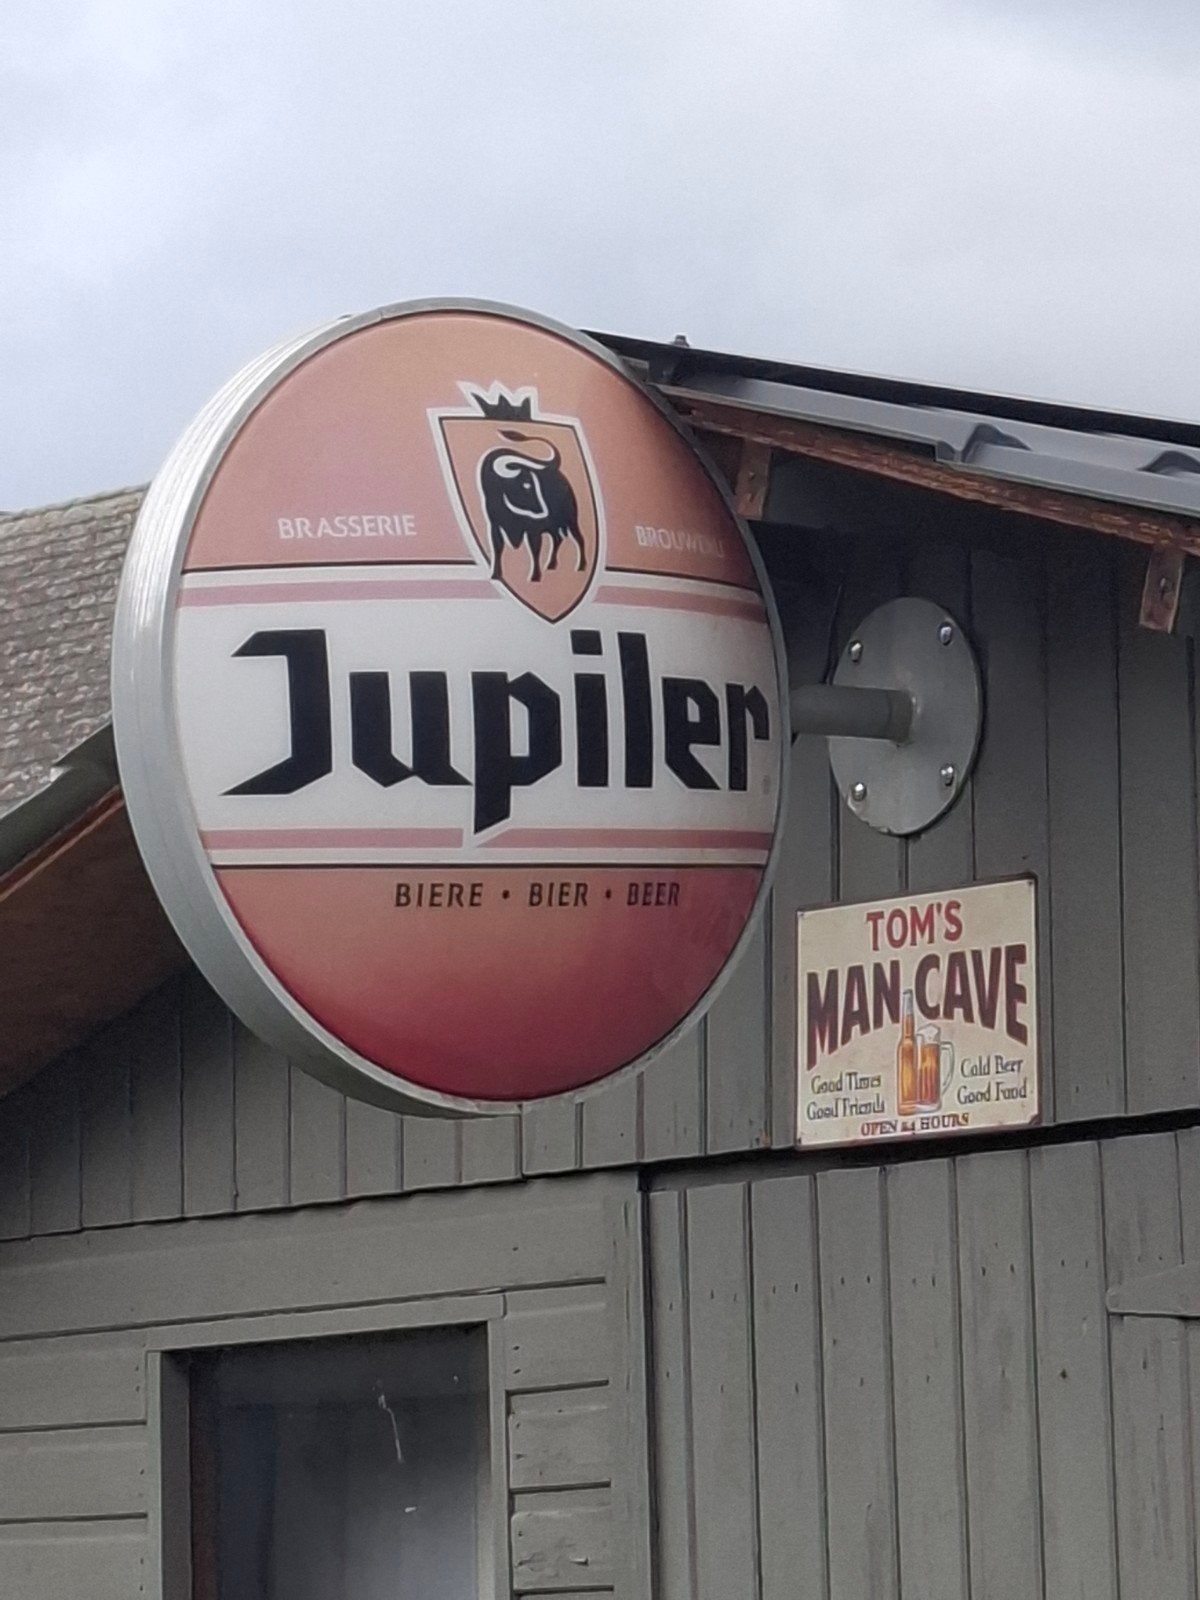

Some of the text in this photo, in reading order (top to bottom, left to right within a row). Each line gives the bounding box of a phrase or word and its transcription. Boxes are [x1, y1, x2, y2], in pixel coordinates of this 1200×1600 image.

[277, 514, 418, 540] BRASSERIE
[634, 525, 725, 559] BROUWIJ
[218, 628, 771, 835] Jupiler
[395, 881, 681, 908] BIERE BIER BEER
[866, 899, 964, 951] TOM'S
[806, 943, 1028, 1072] MAN CAVE
[960, 1054, 991, 1079] Cold
[810, 1071, 843, 1095] Good
[957, 1080, 992, 1105] Good
[806, 1097, 840, 1121] Good
[860, 1119, 898, 1136] OPEN
[920, 1112, 970, 1130] HOURS
